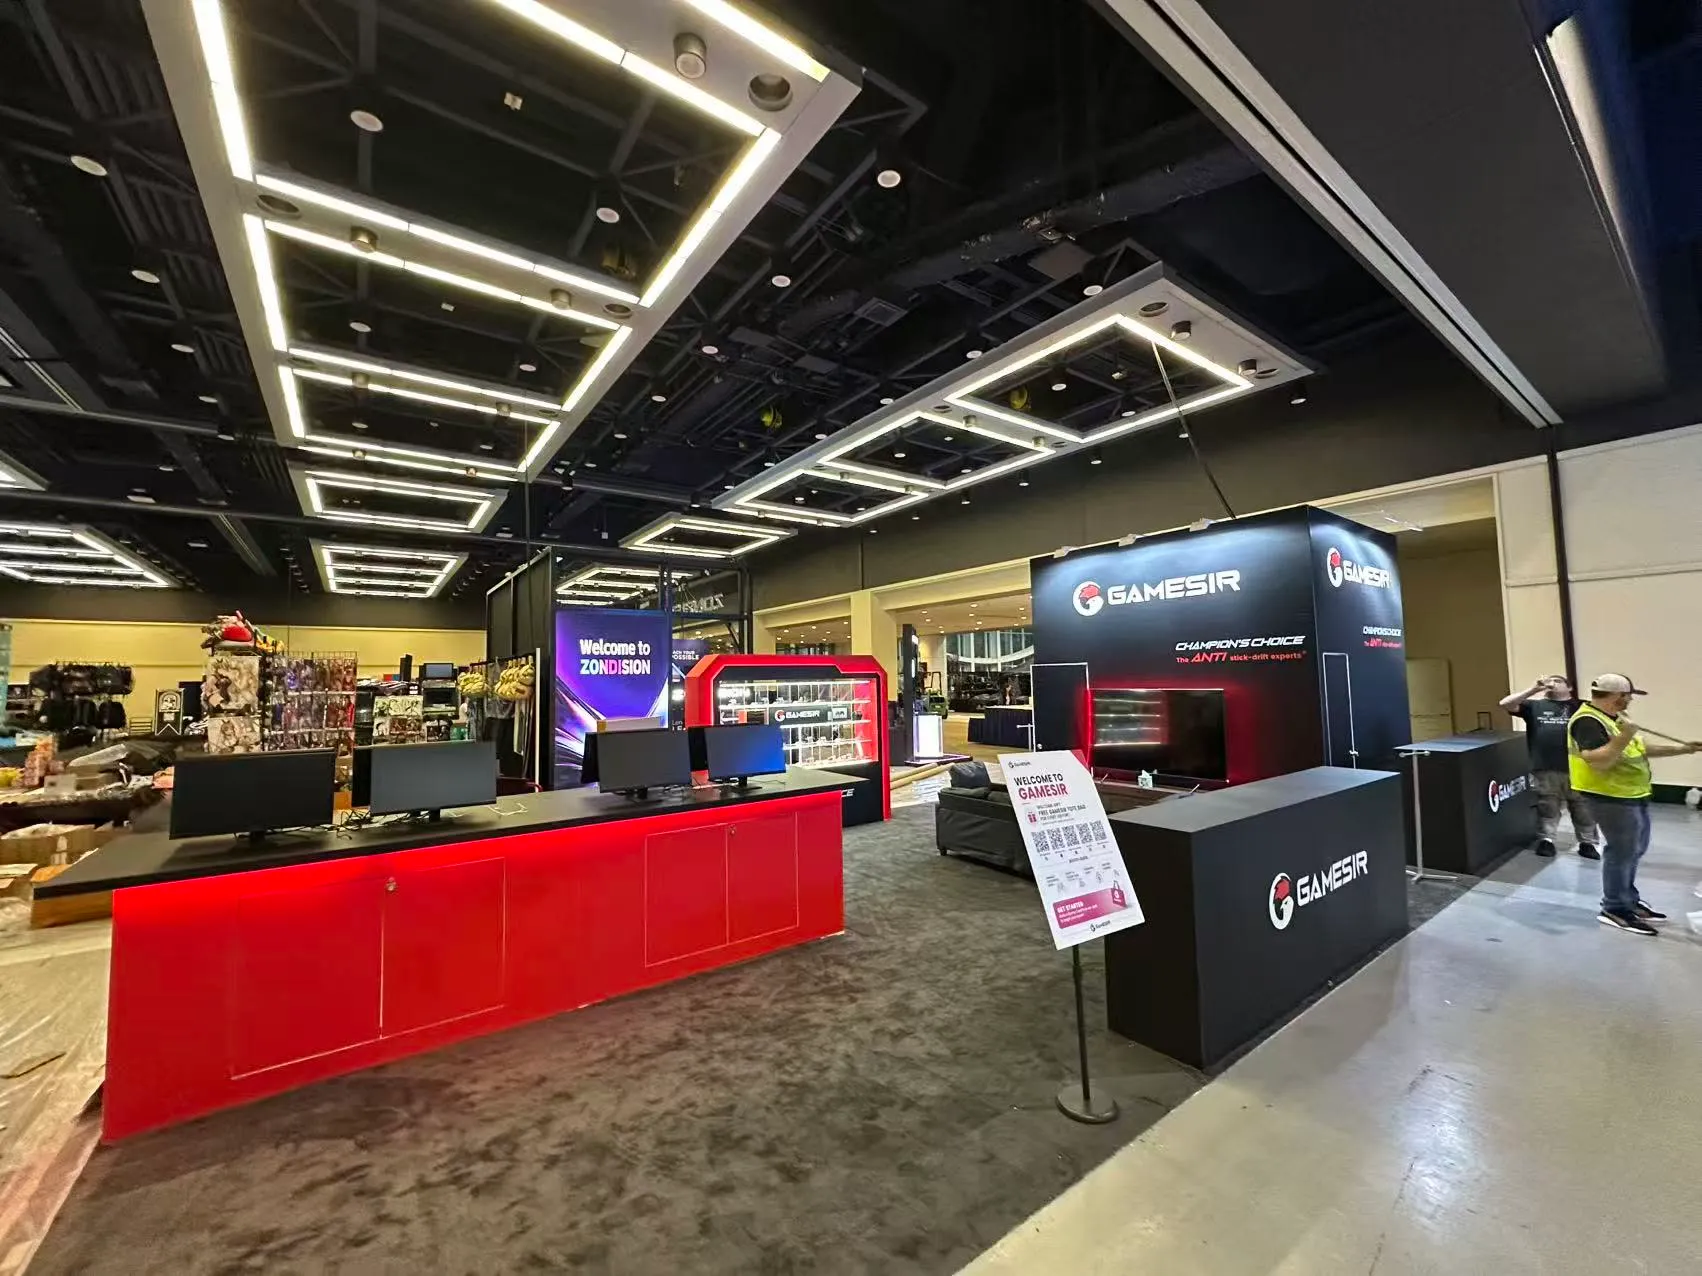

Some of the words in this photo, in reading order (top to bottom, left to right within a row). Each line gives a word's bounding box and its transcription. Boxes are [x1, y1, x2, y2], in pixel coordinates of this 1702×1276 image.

[1343, 560, 1390, 588] GAMESIR
[1107, 569, 1241, 606] GAMESIR
[579, 638, 636, 656] Welcome
[637, 640, 651, 656] to
[1175, 638, 1251, 651] CHAMPION'S
[1250, 635, 1306, 647] CHOICE
[1190, 651, 1228, 663] ANTI
[1230, 653, 1269, 662] stick-drift
[579, 659, 651, 675] ZONDISION
[1013, 774, 1054, 786] WELCOME
[1053, 773, 1064, 783] TO
[1018, 783, 1069, 800] GAMESIR
[1296, 850, 1369, 907] GAMESIR
